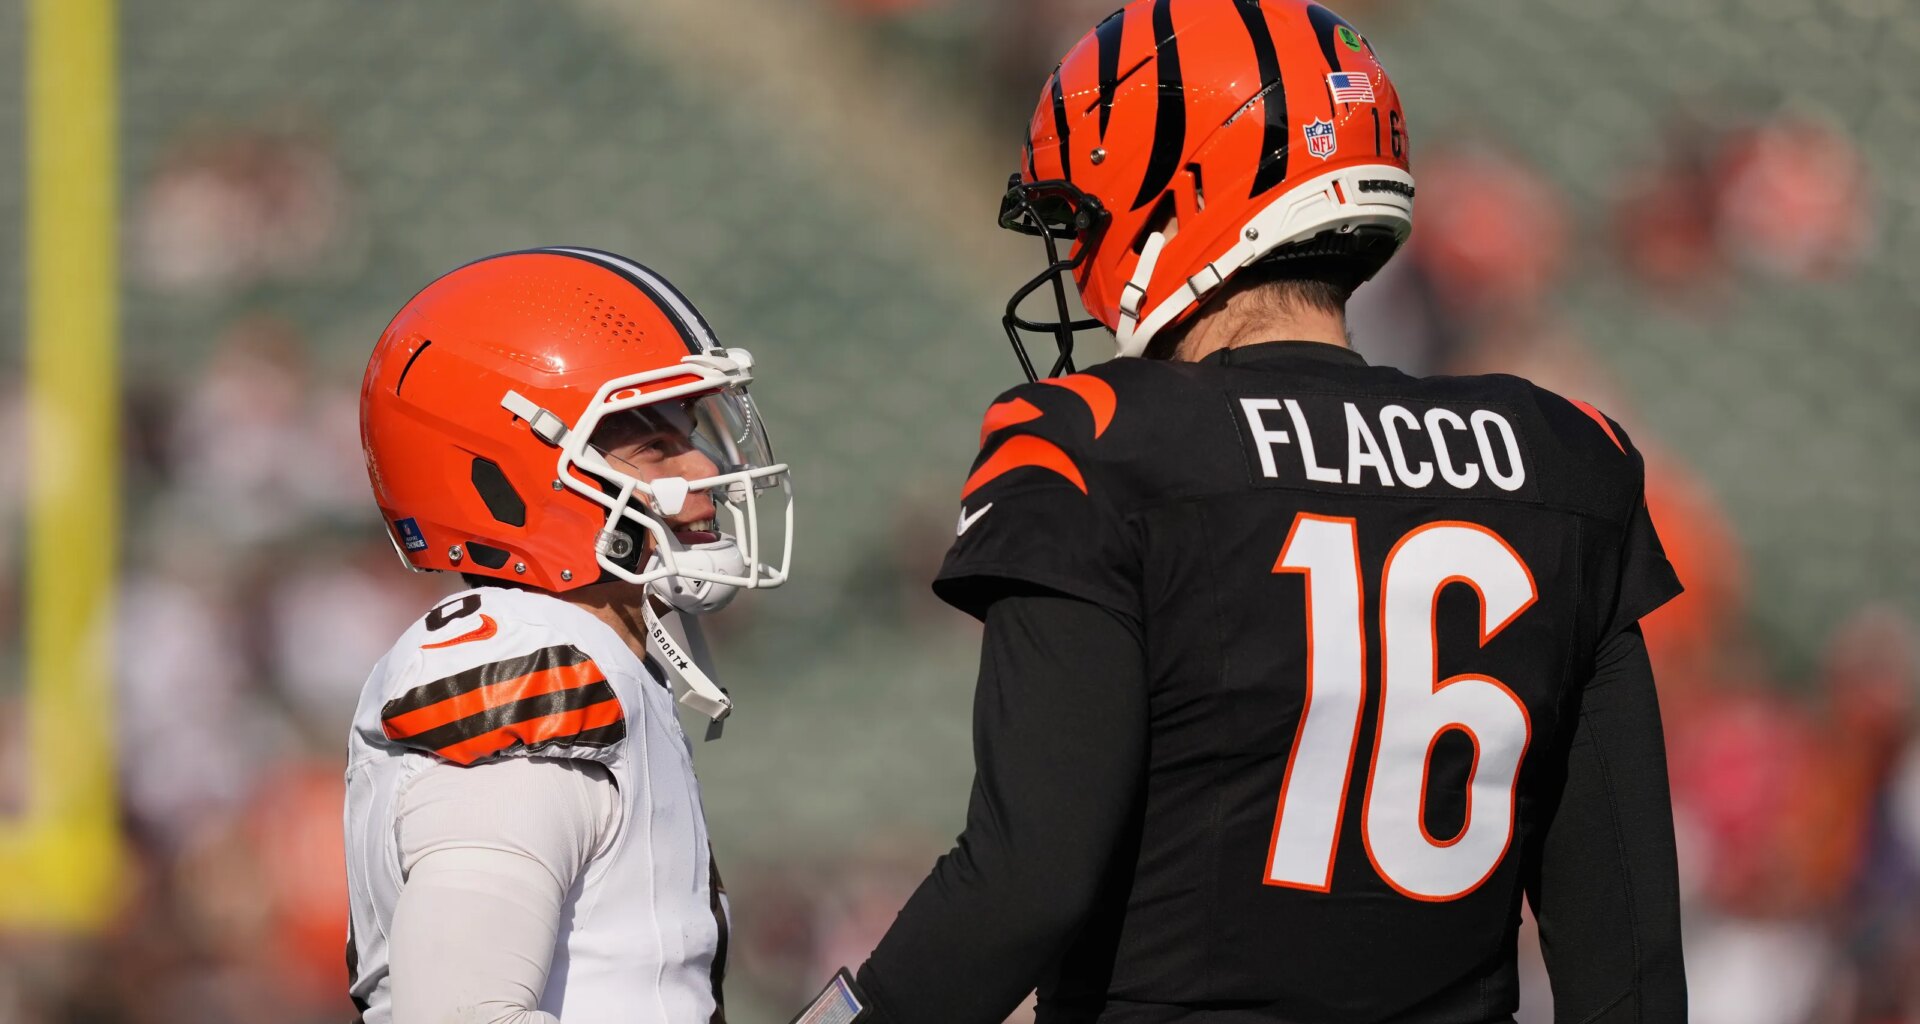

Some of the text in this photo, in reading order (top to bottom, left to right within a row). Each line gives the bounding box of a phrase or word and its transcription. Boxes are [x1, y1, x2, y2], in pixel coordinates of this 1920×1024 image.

[1311, 137, 1333, 152] NFL
[1371, 107, 1401, 158] 16
[1239, 398, 1526, 491] FLACCO
[1262, 511, 1538, 903] 16
